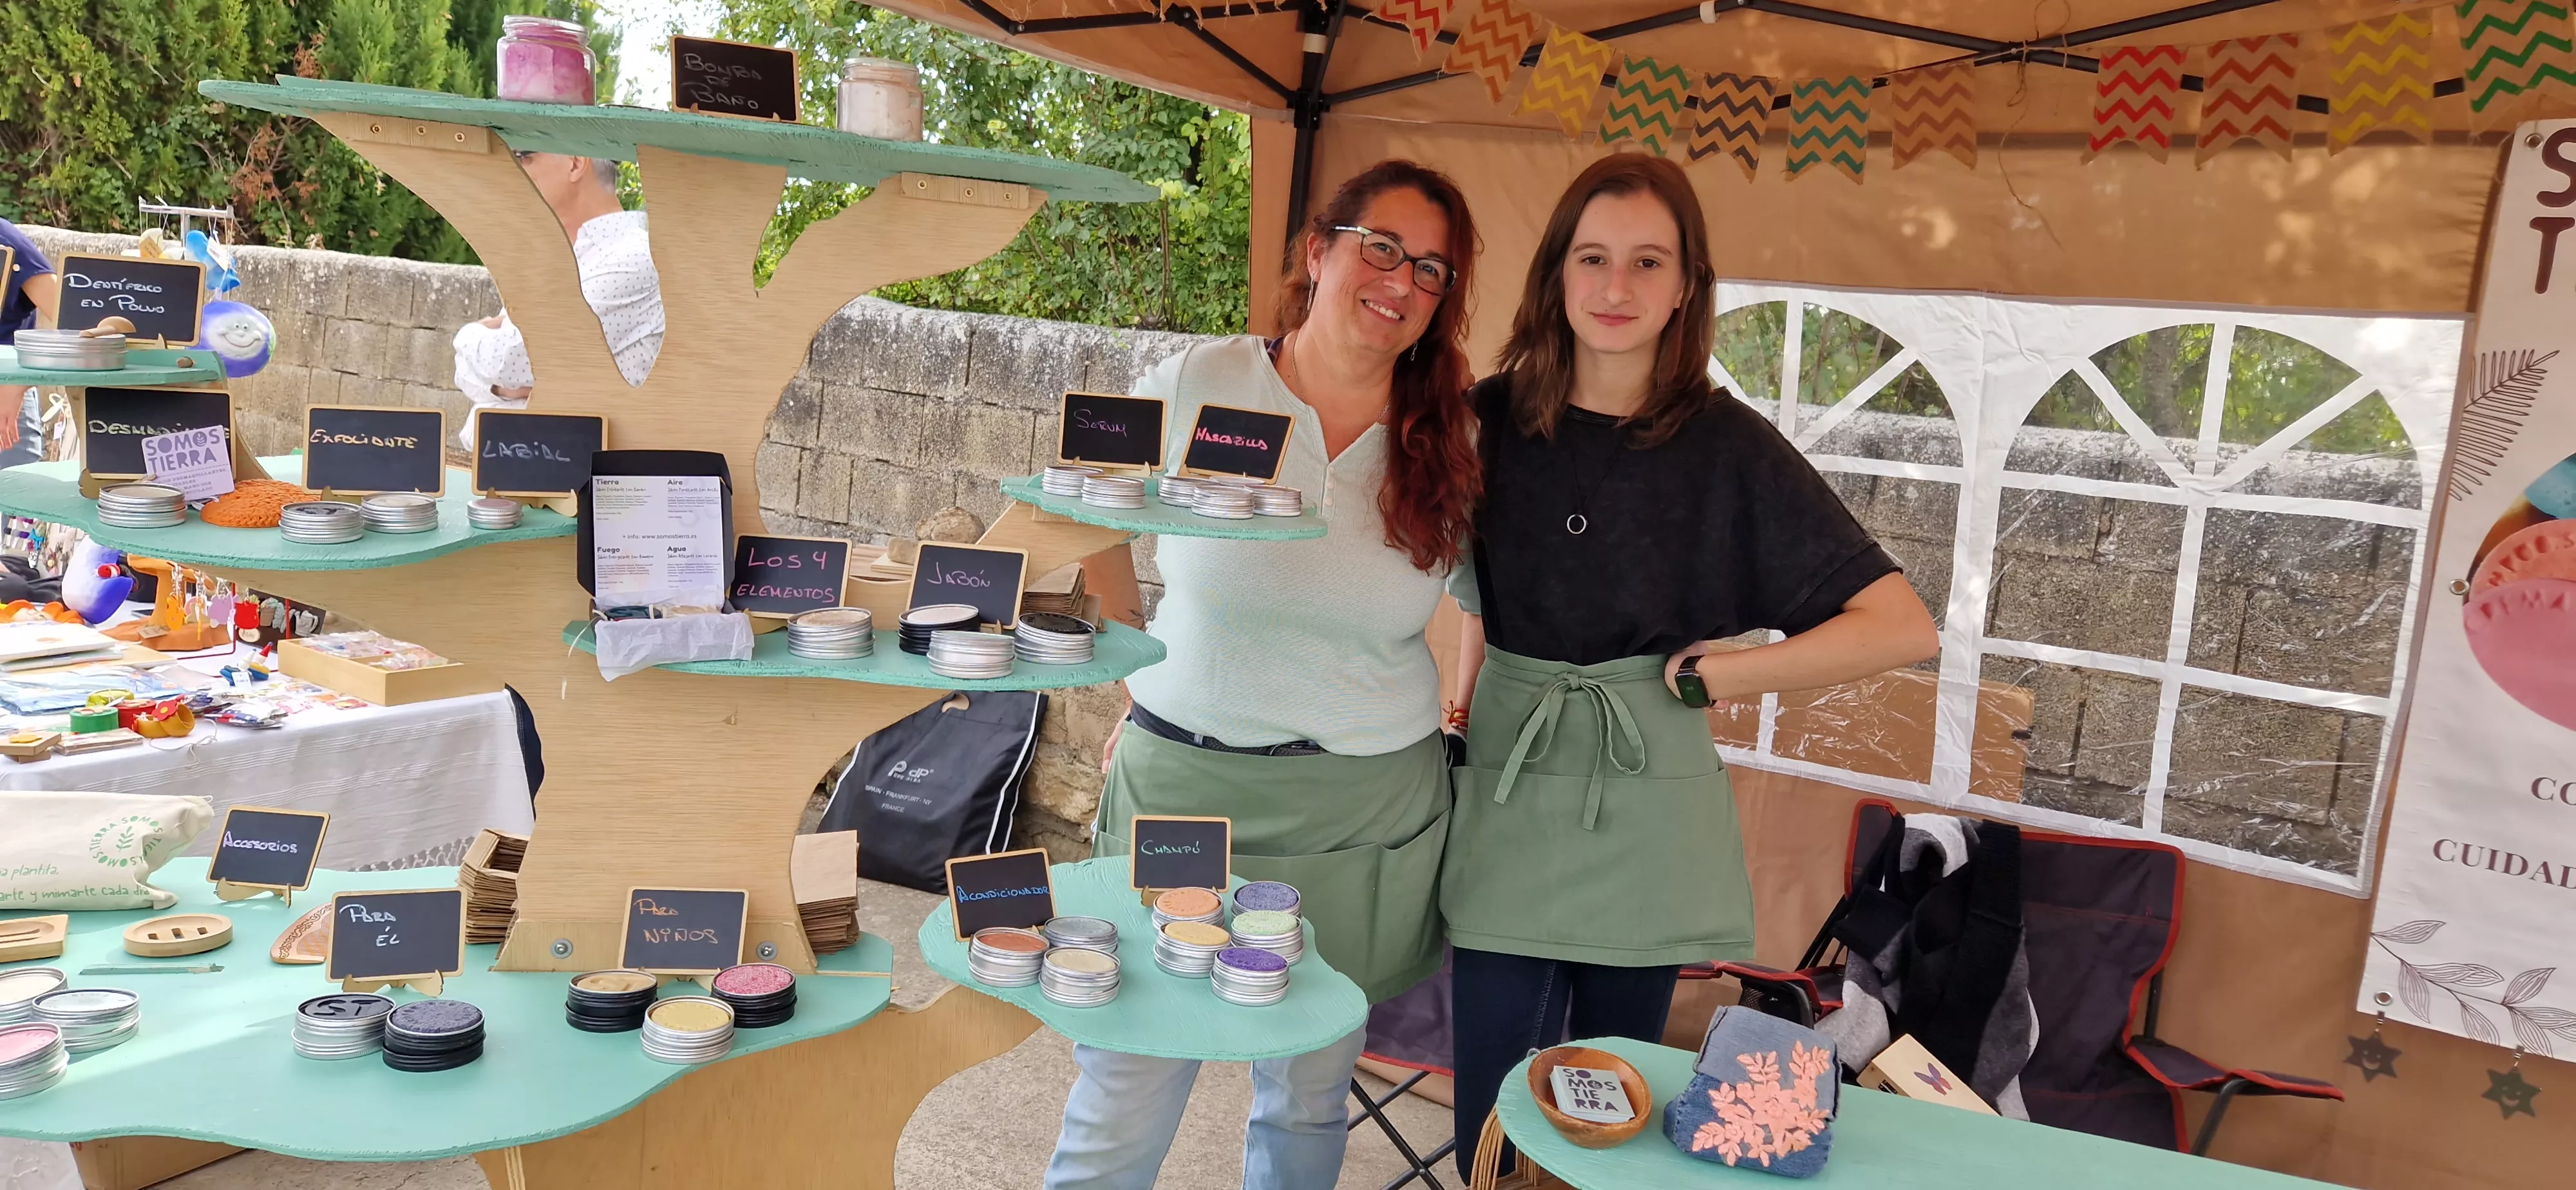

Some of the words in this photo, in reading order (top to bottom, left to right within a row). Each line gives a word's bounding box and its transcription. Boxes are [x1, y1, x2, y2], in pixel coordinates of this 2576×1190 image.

[145, 428, 220, 456] SOMOS
[147, 447, 217, 473] TIERRA
[748, 547, 801, 569] LOS
[811, 550, 827, 571] 4
[735, 583, 835, 603] ELEMENTOS
[865, 784, 882, 794] SPAIN
[886, 790, 920, 802] FRANKFURT
[881, 802, 905, 813] FRANCE
[222, 830, 299, 854] ACCESORIOS
[30, 891, 37, 903] y
[42, 885, 97, 899] mimarte
[101, 884, 129, 896] cada
